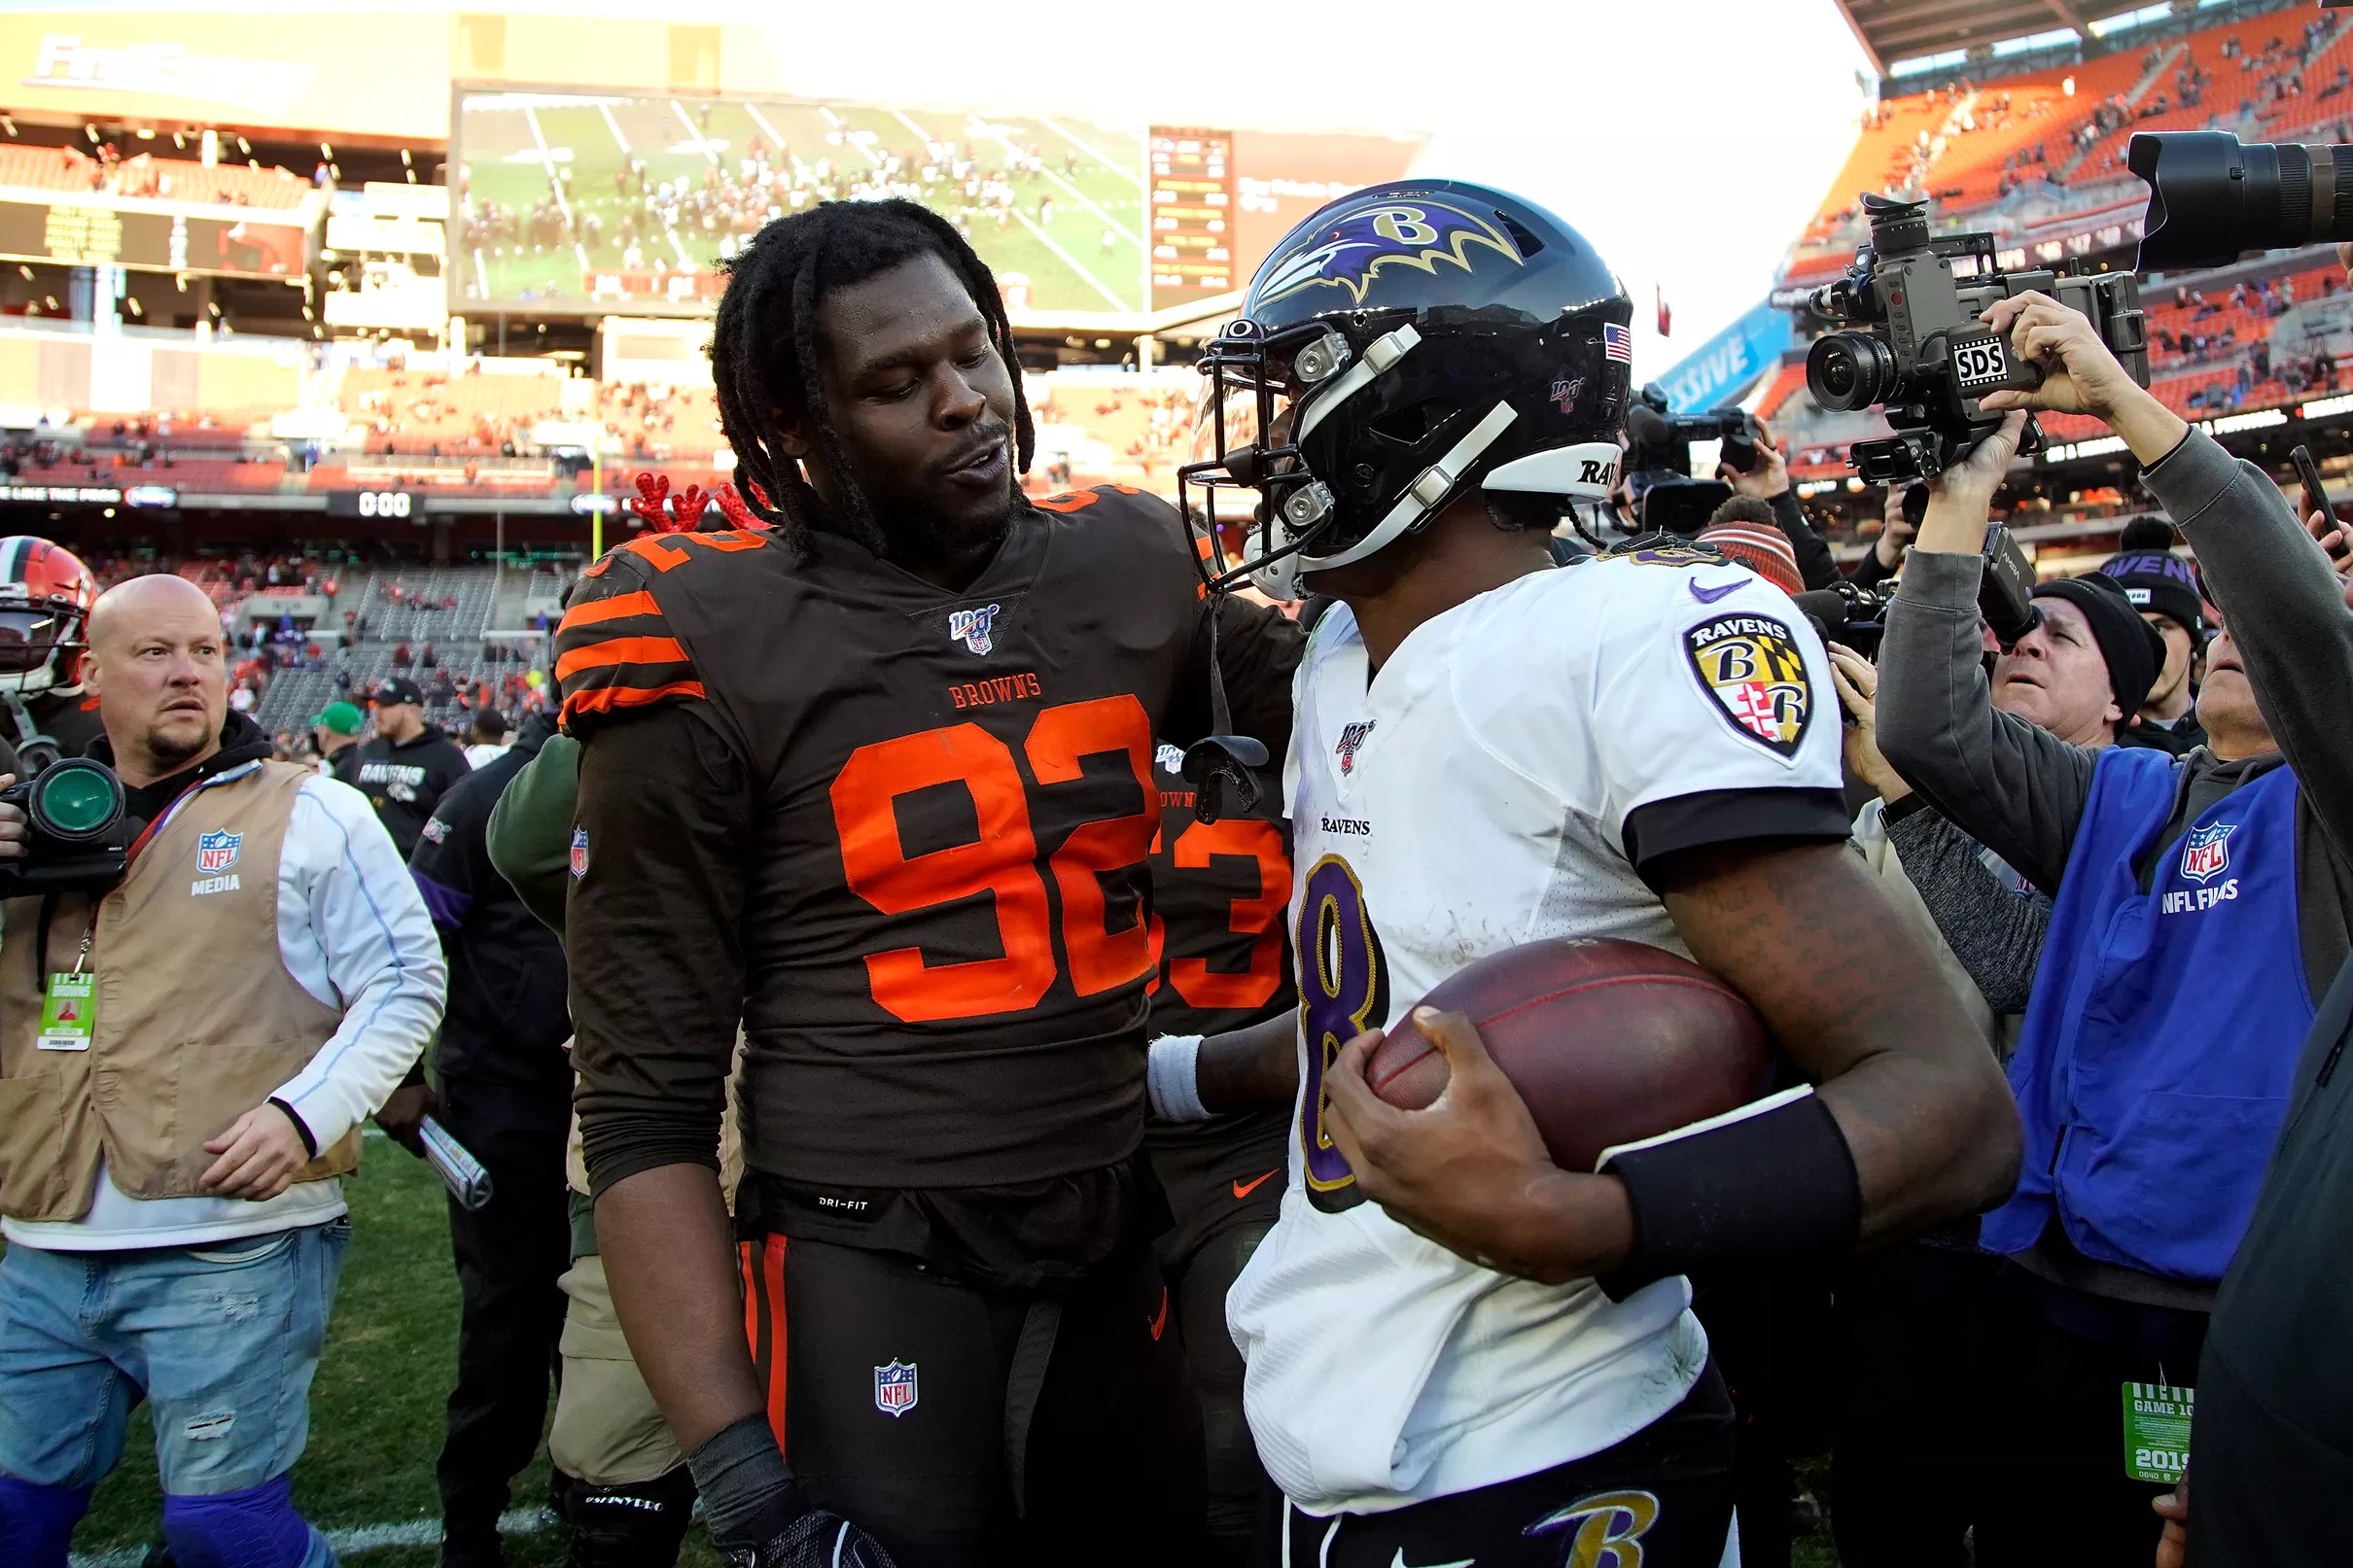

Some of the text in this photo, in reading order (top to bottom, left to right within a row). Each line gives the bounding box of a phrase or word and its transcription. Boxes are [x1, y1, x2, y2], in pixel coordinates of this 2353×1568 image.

[1957, 344, 2003, 379] SDS
[359, 492, 410, 517] 0:00
[1691, 619, 1787, 646] RAVENS
[949, 673, 1041, 709] BROWNS
[358, 764, 426, 786] RAVENS
[1321, 817, 1371, 836] RAVENS
[202, 849, 234, 869] NFL
[828, 693, 1161, 1024] 92
[2186, 843, 2223, 874] NFL
[191, 873, 240, 896] MEDIA
[2161, 890, 2195, 915] NFL
[819, 1197, 868, 1210] DRI-FIT
[882, 1384, 912, 1407] NFL
[2134, 1400, 2176, 1415] GAME
